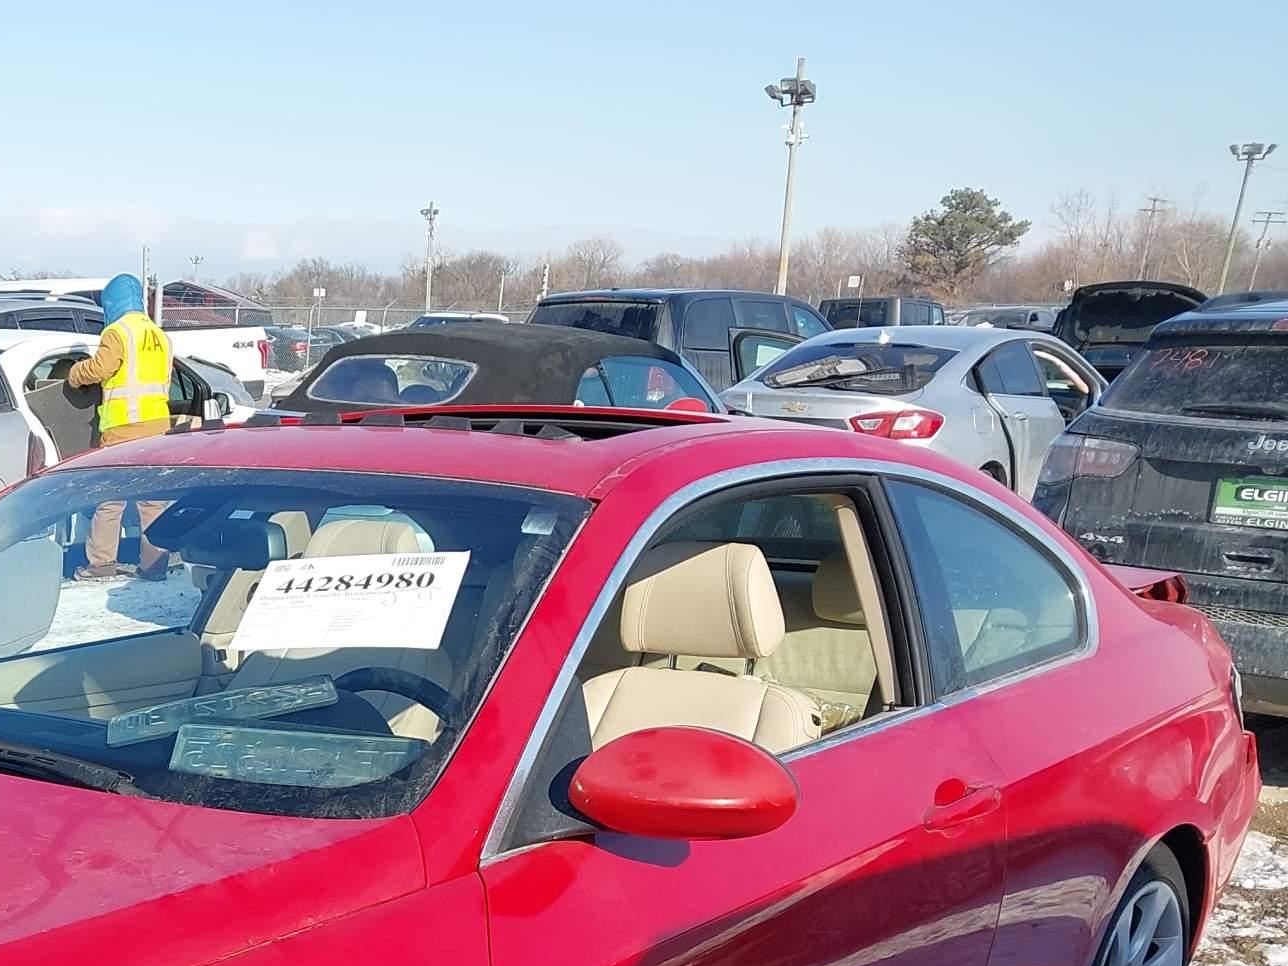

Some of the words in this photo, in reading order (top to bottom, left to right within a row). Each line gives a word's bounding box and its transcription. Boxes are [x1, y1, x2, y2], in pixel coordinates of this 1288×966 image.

[231, 340, 254, 349] 4x4
[1247, 434, 1288, 452] Jee
[1240, 487, 1288, 503] ELGI
[1079, 532, 1125, 544] 4x4
[275, 571, 435, 594] 44284980
